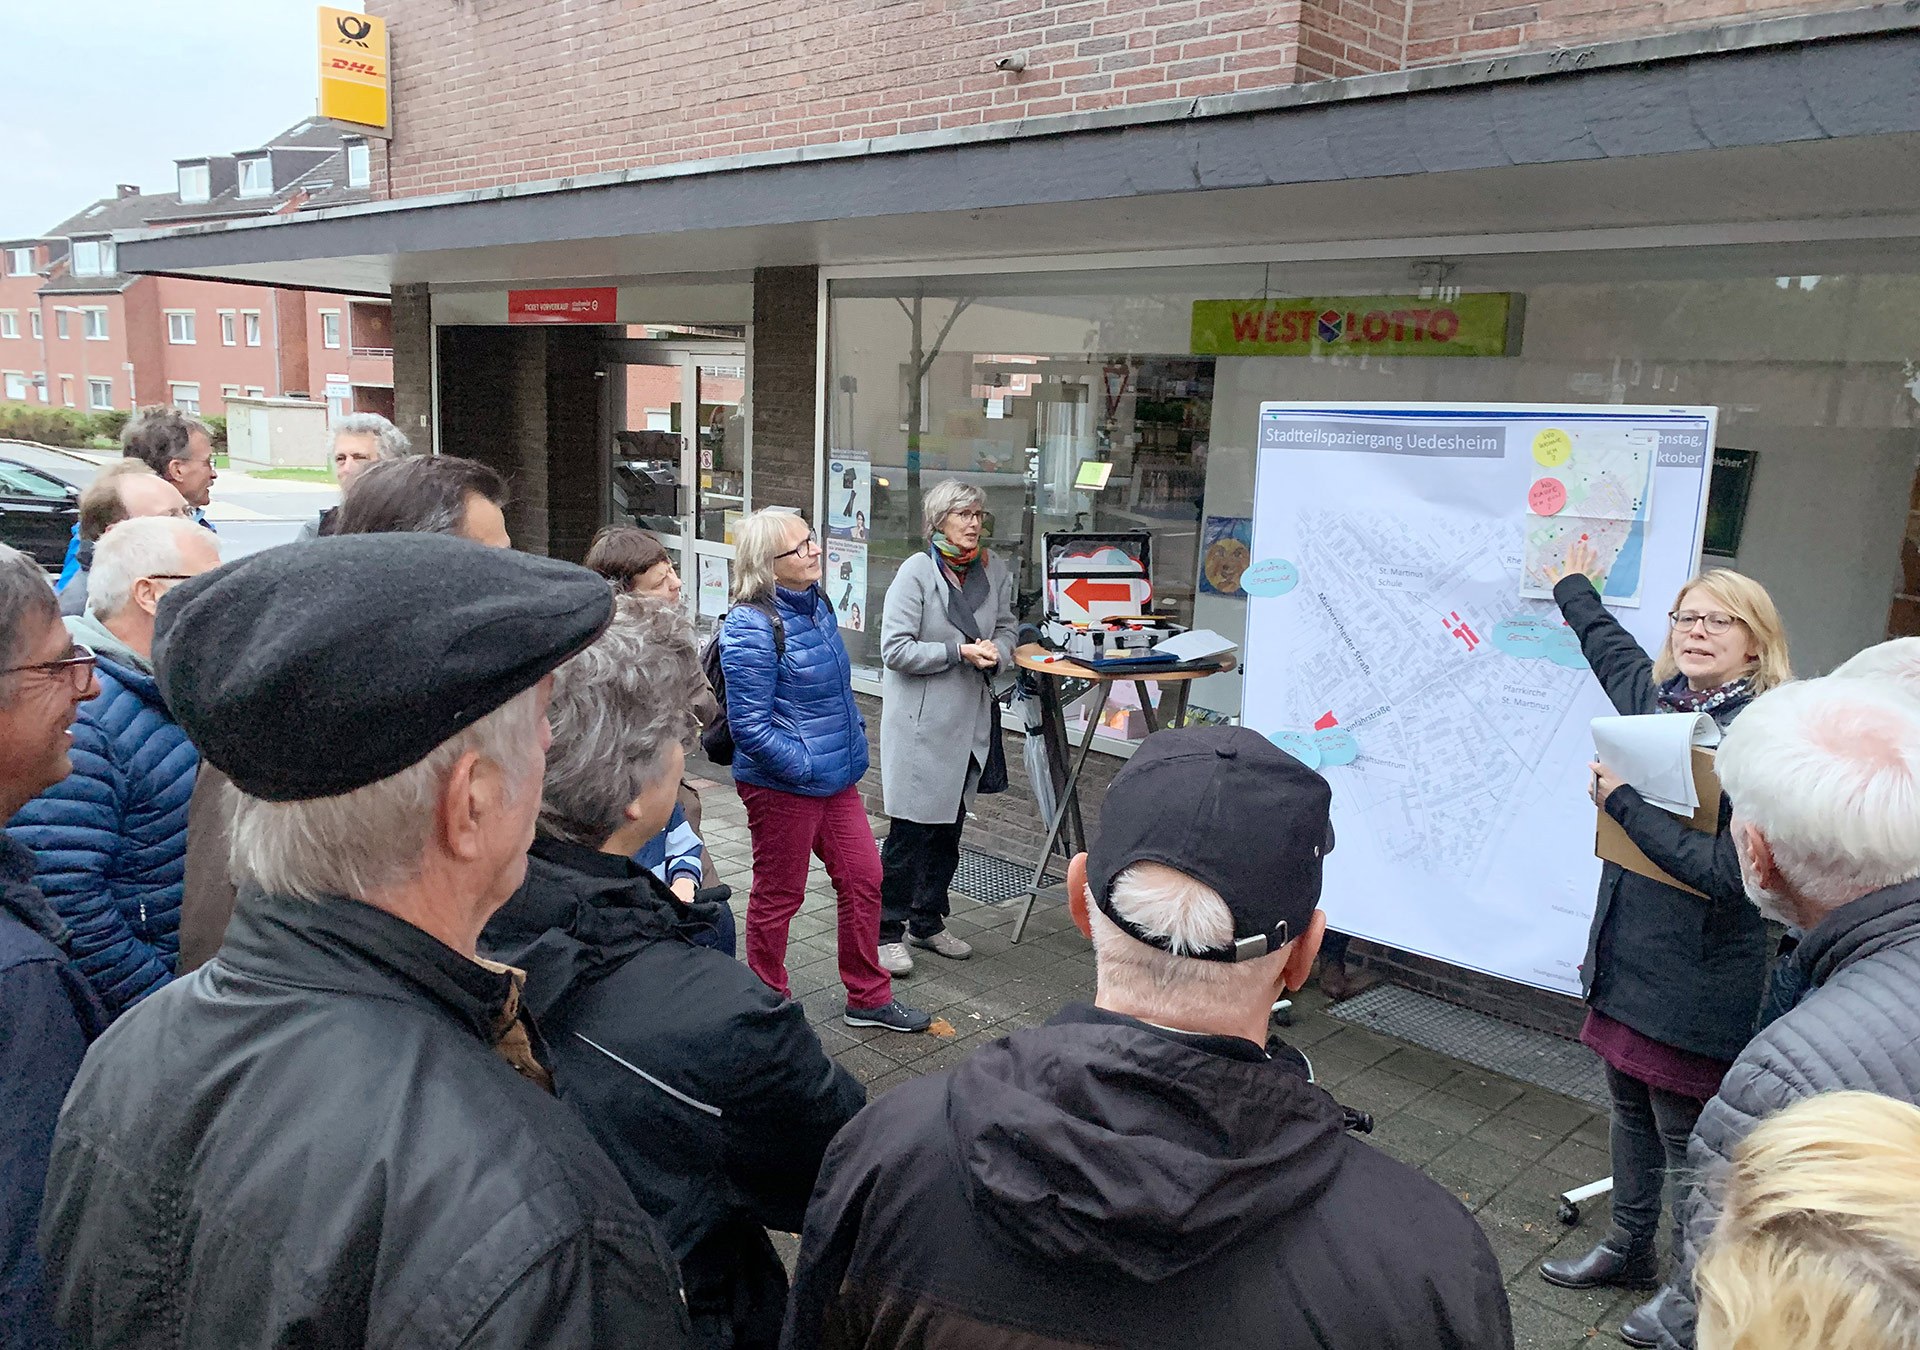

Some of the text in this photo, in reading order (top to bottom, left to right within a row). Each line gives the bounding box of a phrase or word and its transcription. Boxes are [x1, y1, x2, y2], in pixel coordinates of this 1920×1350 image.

[331, 58, 378, 77] DHL
[1231, 308, 1460, 343] WEST LOTTO
[1265, 427, 1498, 451] Stadtteilspaziergang Uedesheim
[1658, 434, 1703, 448] enstag,
[1657, 451, 1702, 464] ktober
[1506, 556, 1522, 565] Rhe
[1391, 568, 1424, 578] Martinus
[1378, 578, 1403, 588] Schule
[1503, 684, 1547, 698] Pfarrkirche
[1513, 697, 1551, 711] Martinus
[1345, 704, 1392, 733] einfahrstraße
[1355, 754, 1407, 770] schäftszentrum
